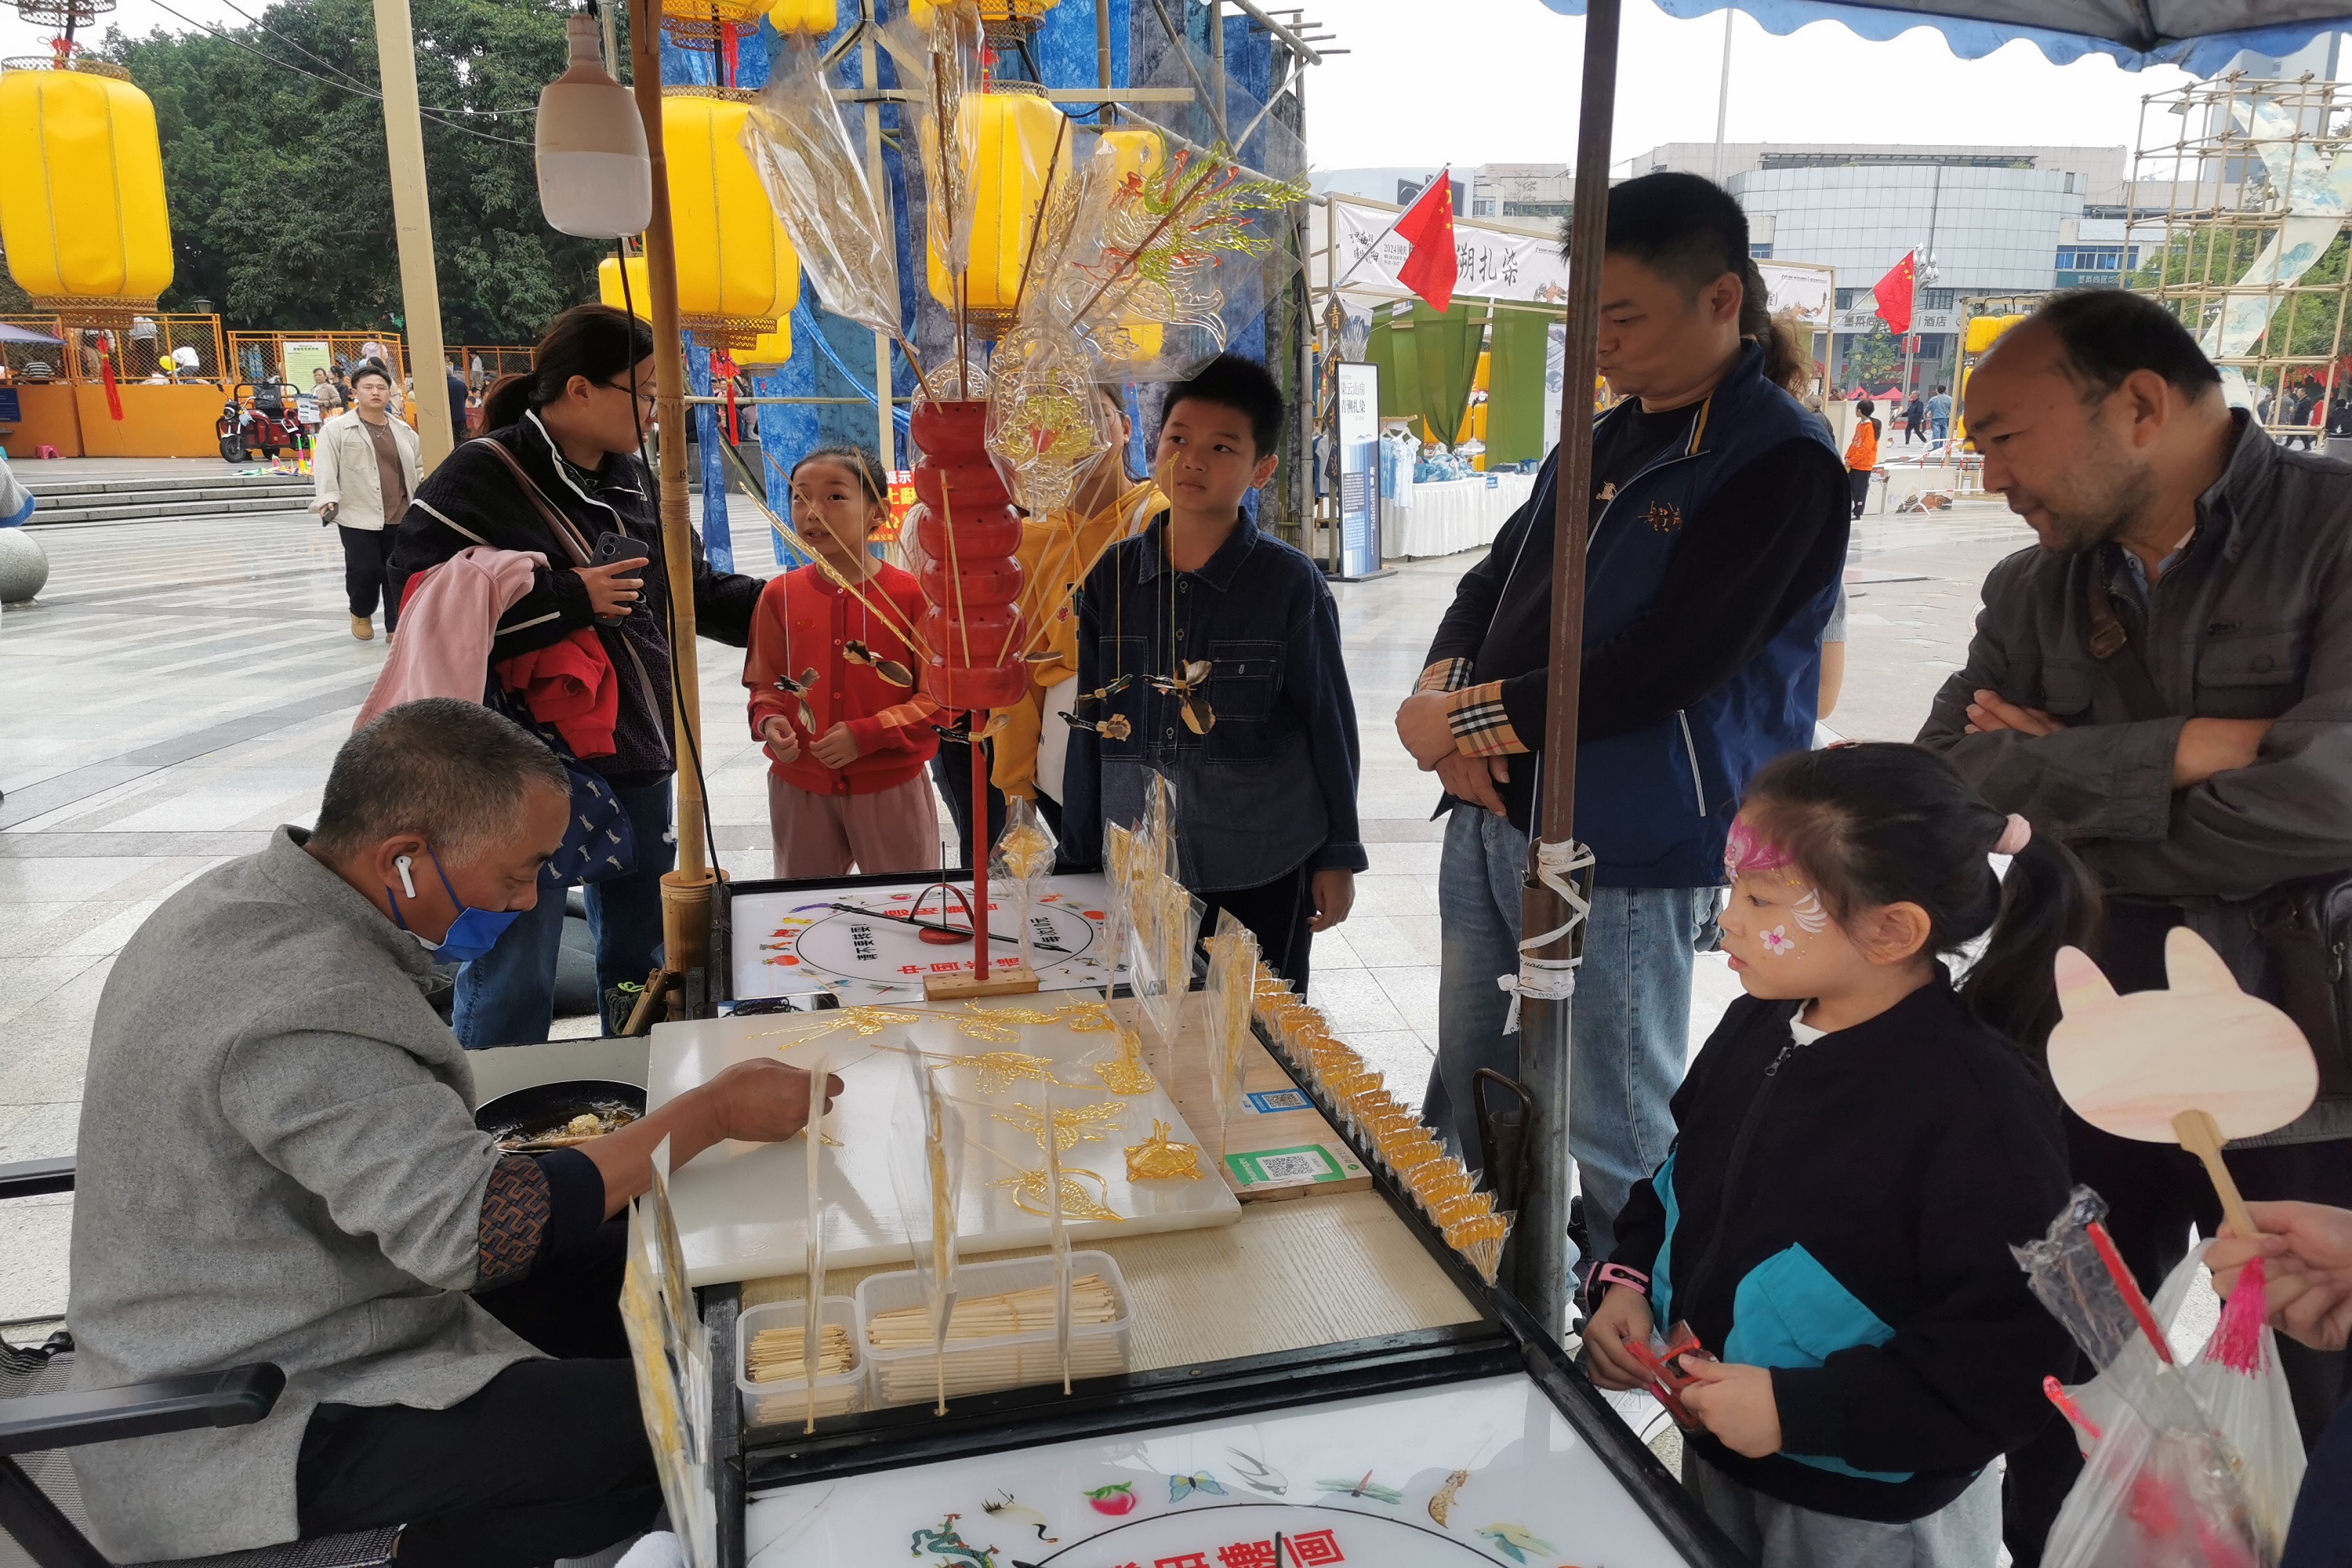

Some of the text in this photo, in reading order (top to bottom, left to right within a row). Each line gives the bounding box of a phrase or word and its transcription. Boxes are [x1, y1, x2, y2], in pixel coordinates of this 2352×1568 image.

[1329, 304, 1341, 330] 青
[1924, 316, 1947, 327] 酒店
[1030, 916, 1061, 942] 每次10元
